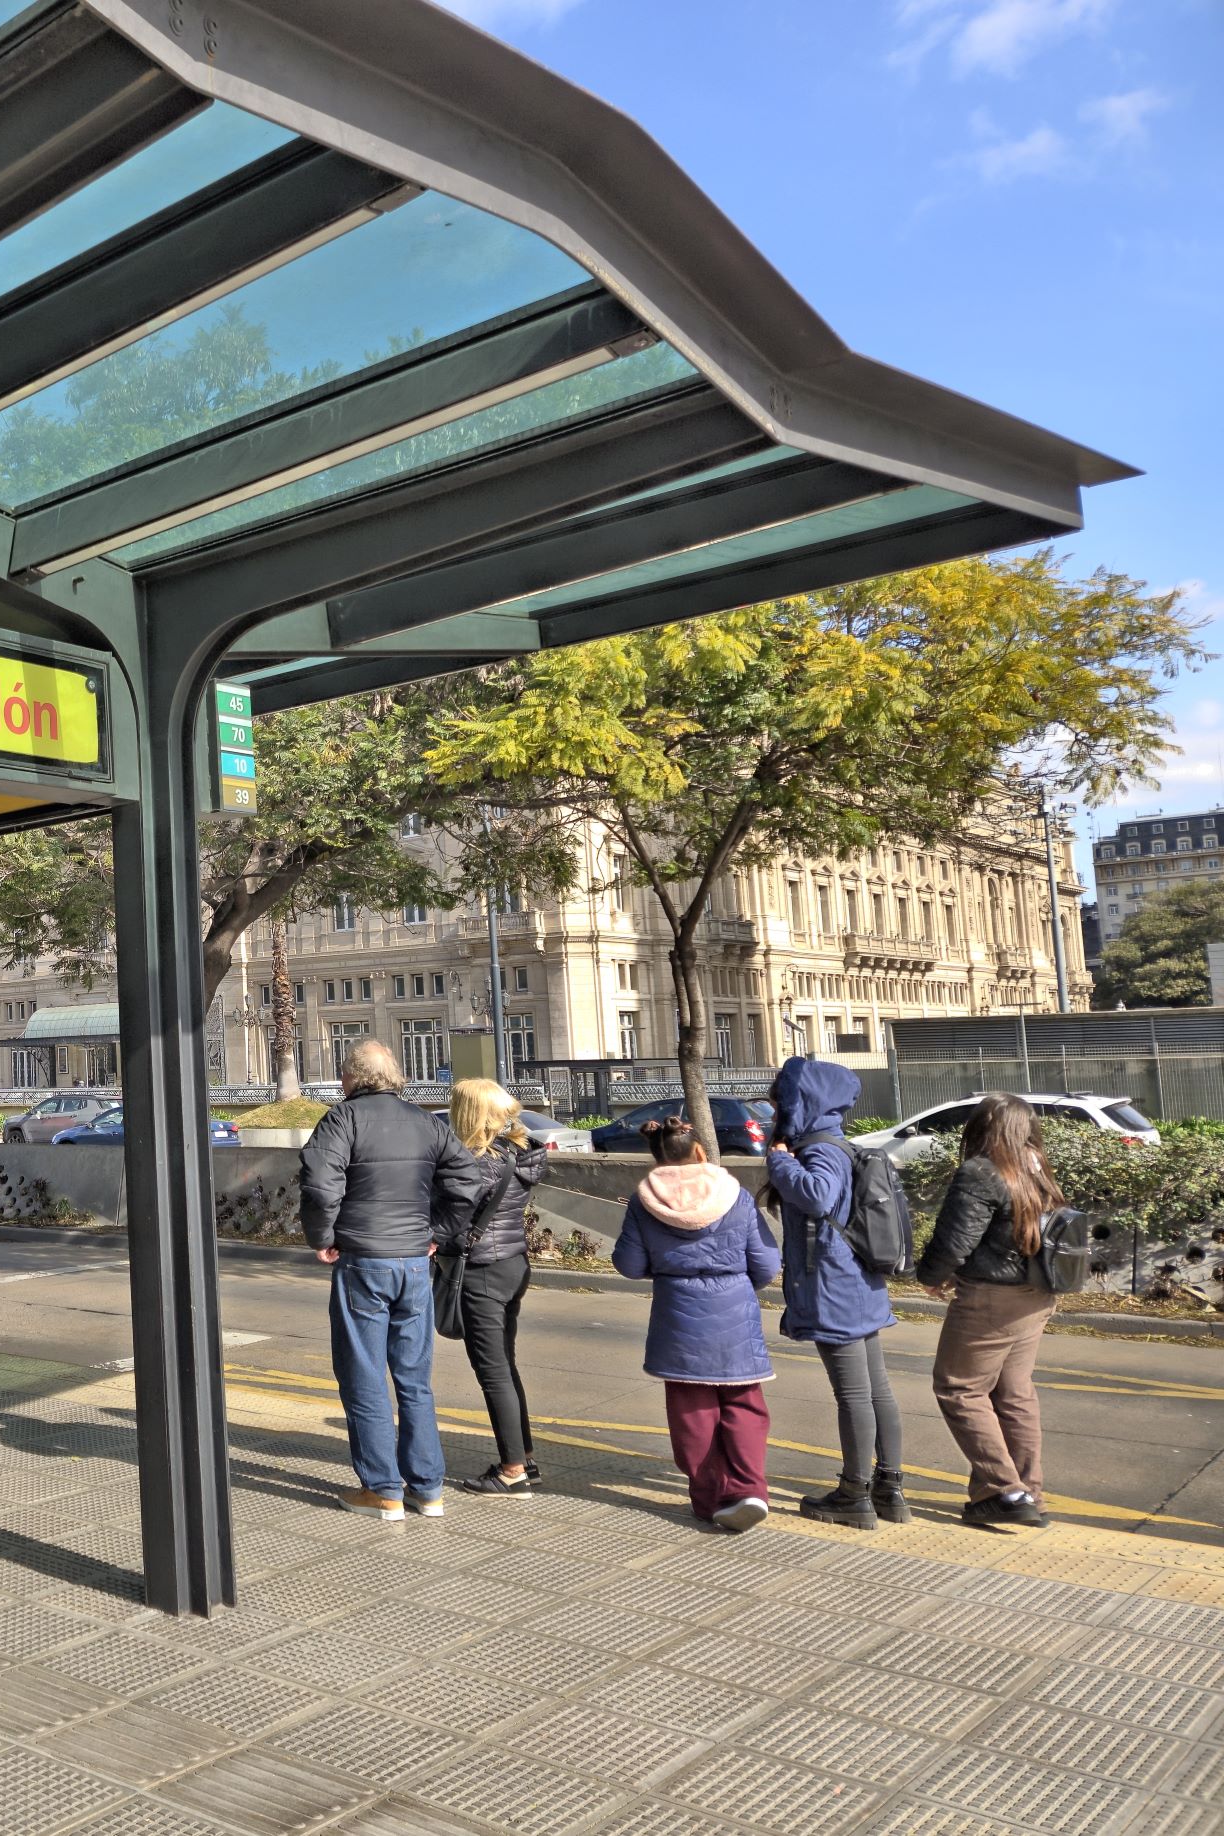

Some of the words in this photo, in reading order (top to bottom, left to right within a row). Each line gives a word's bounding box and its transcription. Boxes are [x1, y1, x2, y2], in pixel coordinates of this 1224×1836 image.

[229, 696, 244, 712] 45
[231, 727, 245, 743] 70
[234, 758, 247, 773] 10
[235, 789, 249, 805] 39
